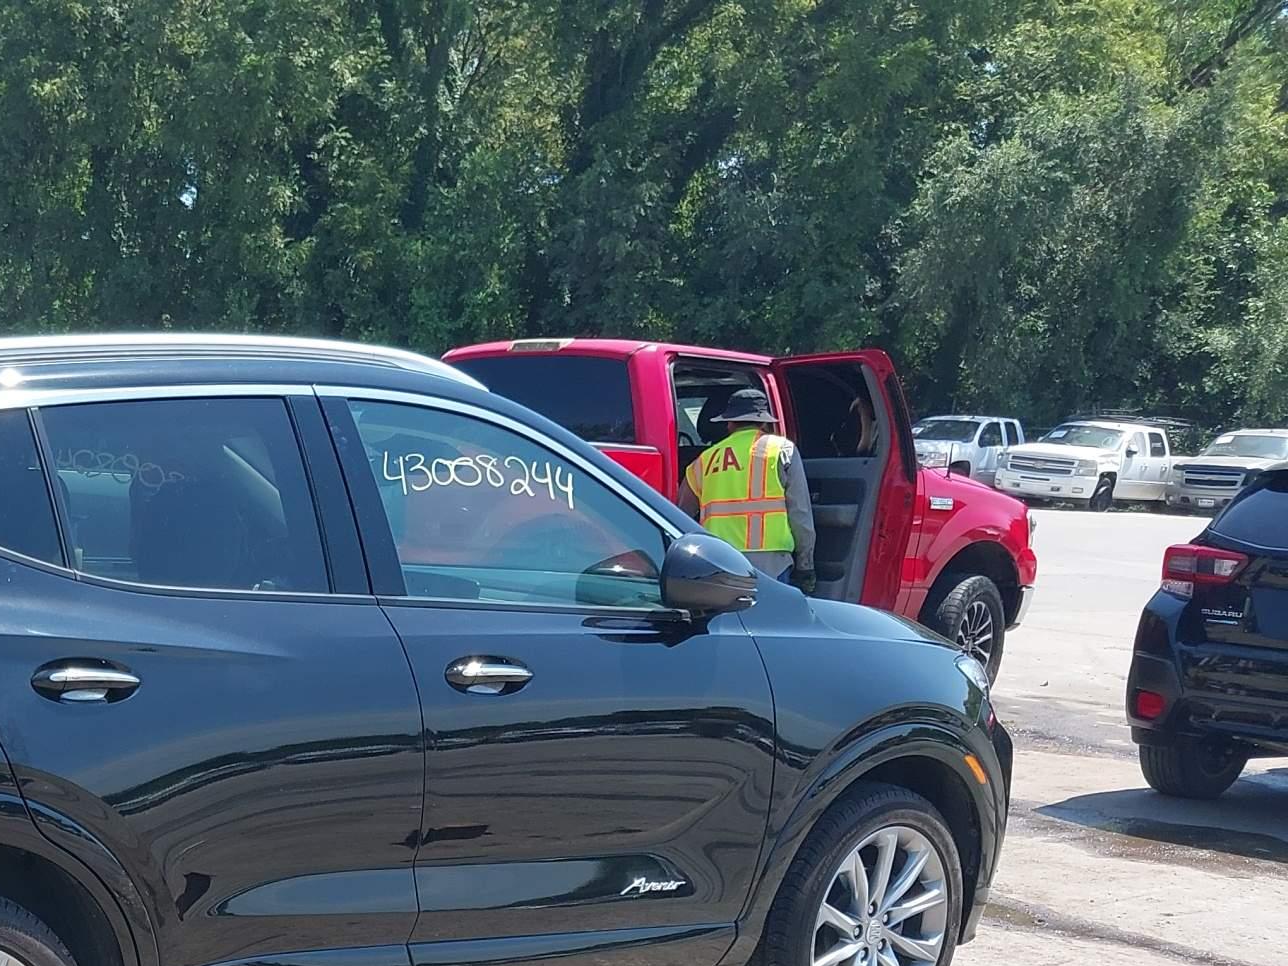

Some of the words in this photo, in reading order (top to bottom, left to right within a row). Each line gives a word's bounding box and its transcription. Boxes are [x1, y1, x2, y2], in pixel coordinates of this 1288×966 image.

[383, 451, 575, 510] 43008244
[1200, 607, 1243, 618] SUBARU
[620, 877, 687, 895] Avenir
